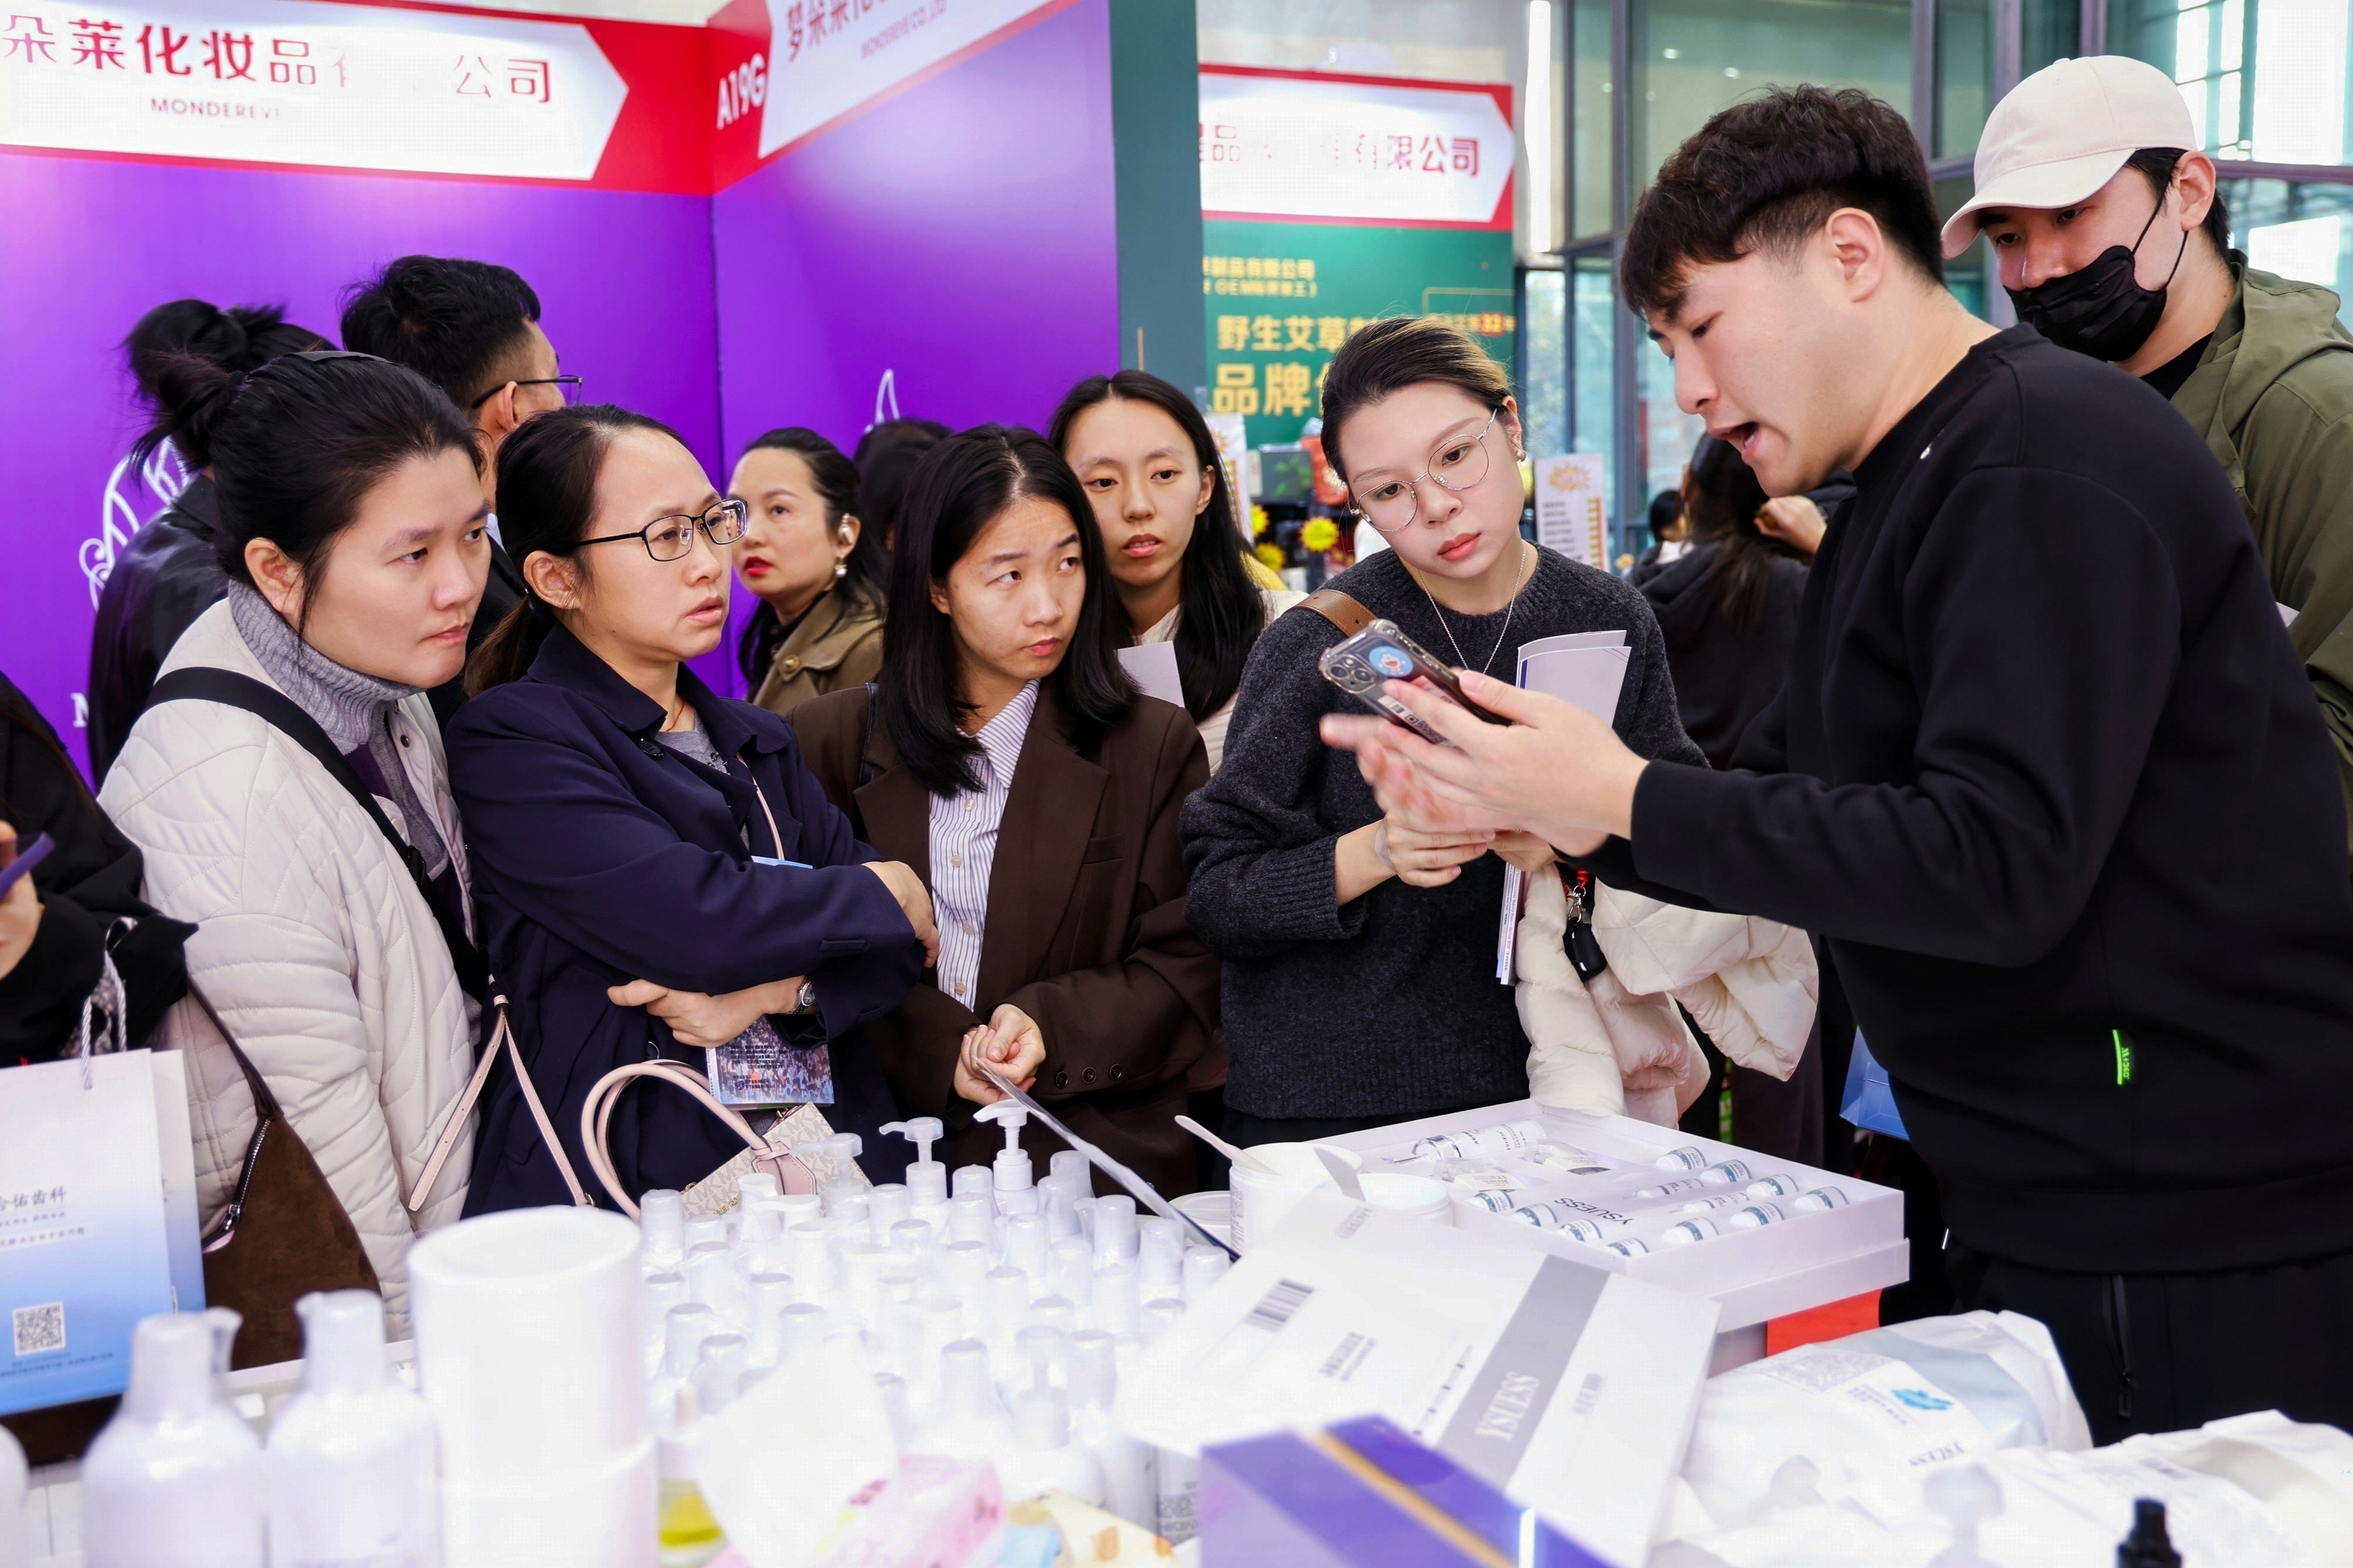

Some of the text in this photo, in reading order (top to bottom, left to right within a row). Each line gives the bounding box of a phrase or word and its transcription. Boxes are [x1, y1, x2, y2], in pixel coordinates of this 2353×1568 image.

[716, 53, 765, 131] A19G
[1217, 314, 1380, 353] 野生艾草
[1212, 362, 1330, 417] 品牌
[1554, 1198, 1633, 1225] YSUESS
